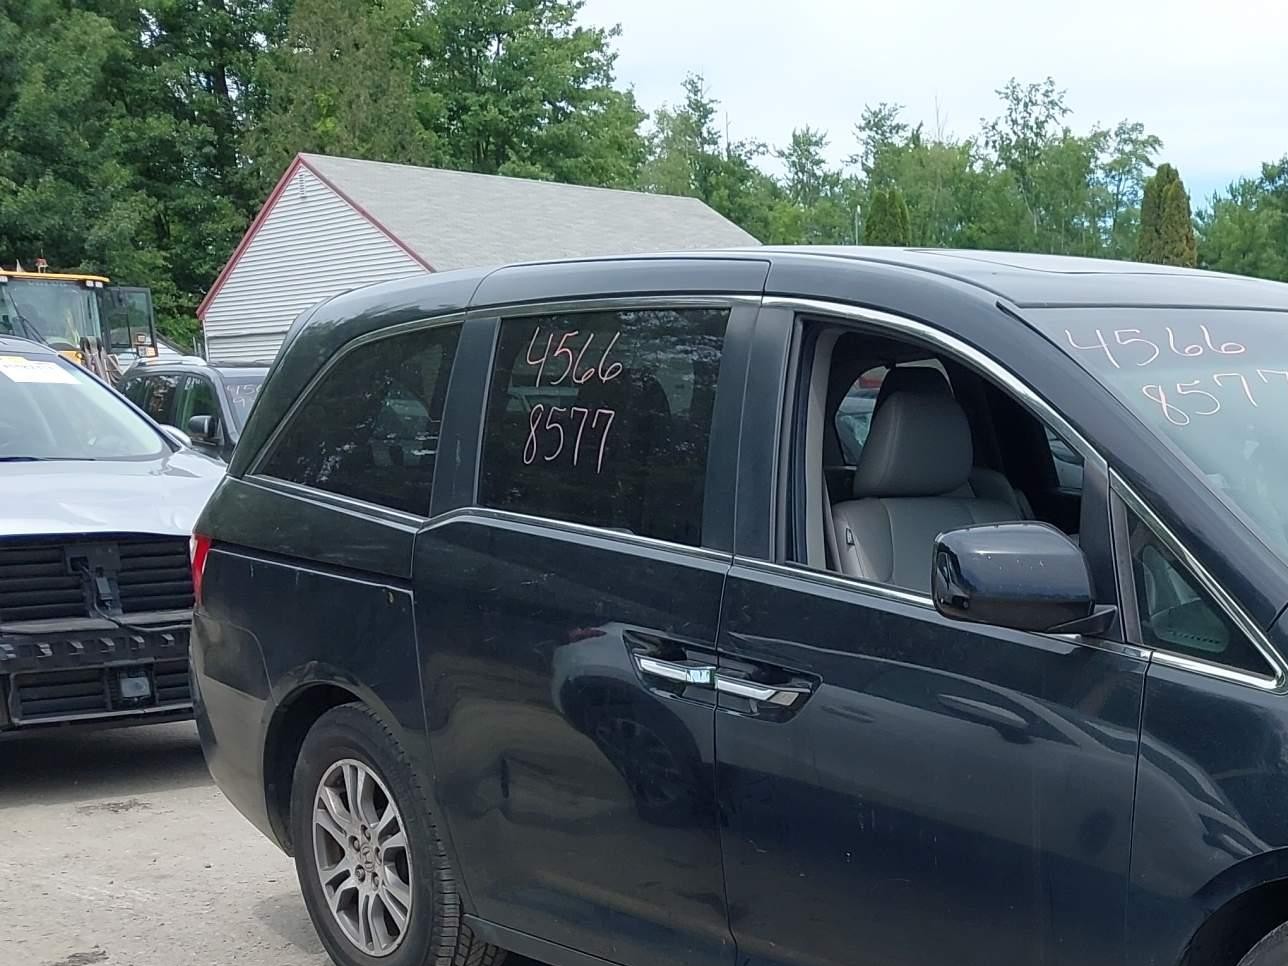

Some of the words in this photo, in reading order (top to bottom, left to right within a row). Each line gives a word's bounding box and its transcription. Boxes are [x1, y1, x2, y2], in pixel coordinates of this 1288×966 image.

[525, 326, 623, 388] 4566
[1064, 324, 1247, 368] 4566
[523, 403, 616, 475] 8577
